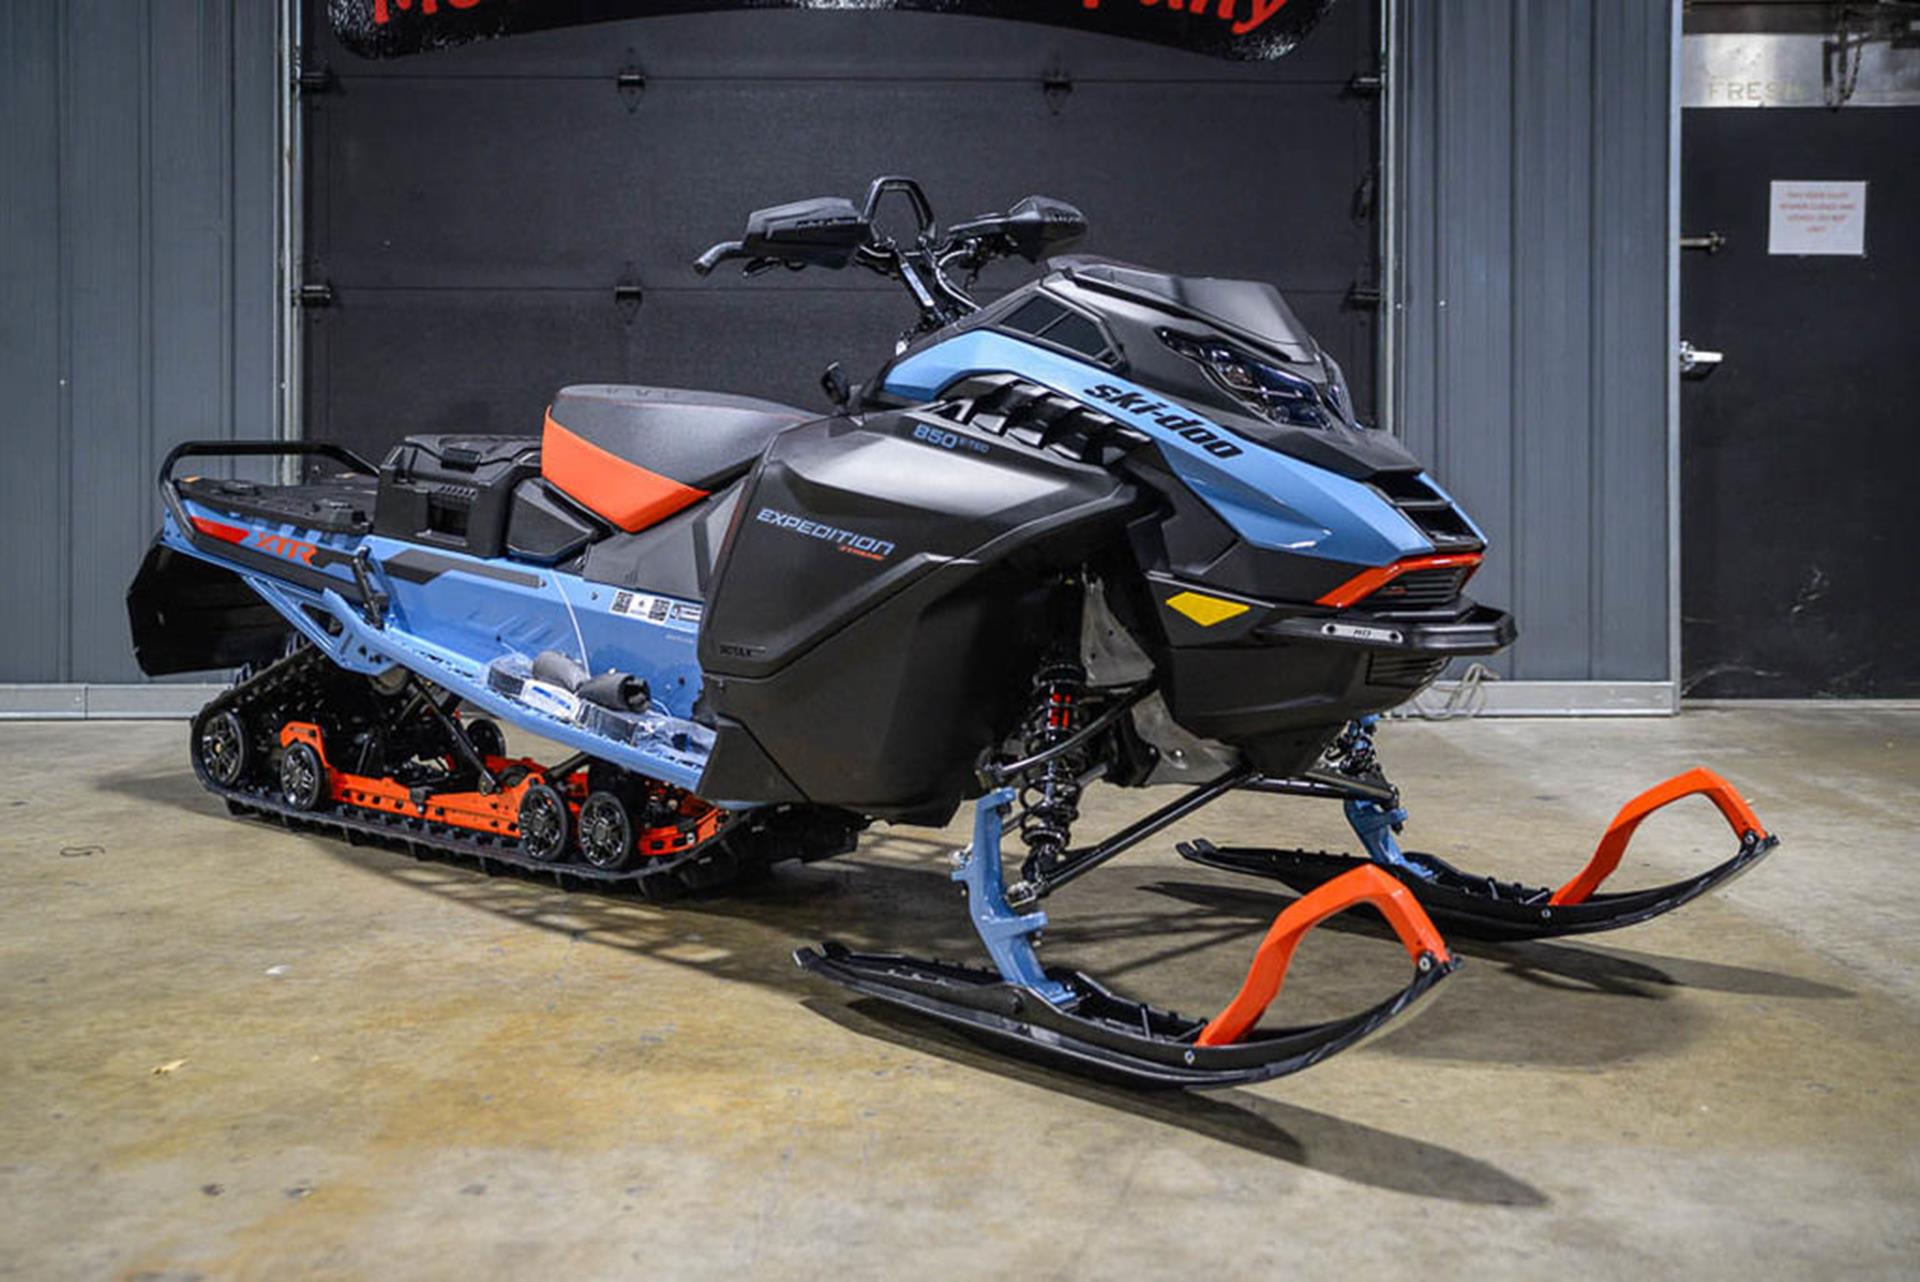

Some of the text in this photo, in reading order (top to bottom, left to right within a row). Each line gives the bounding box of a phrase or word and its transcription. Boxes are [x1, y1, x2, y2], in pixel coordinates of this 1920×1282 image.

[913, 423, 958, 449] 850
[1084, 383, 1244, 459] ski-doo
[256, 531, 317, 567] XTR
[756, 508, 896, 556] EXPEDITION
